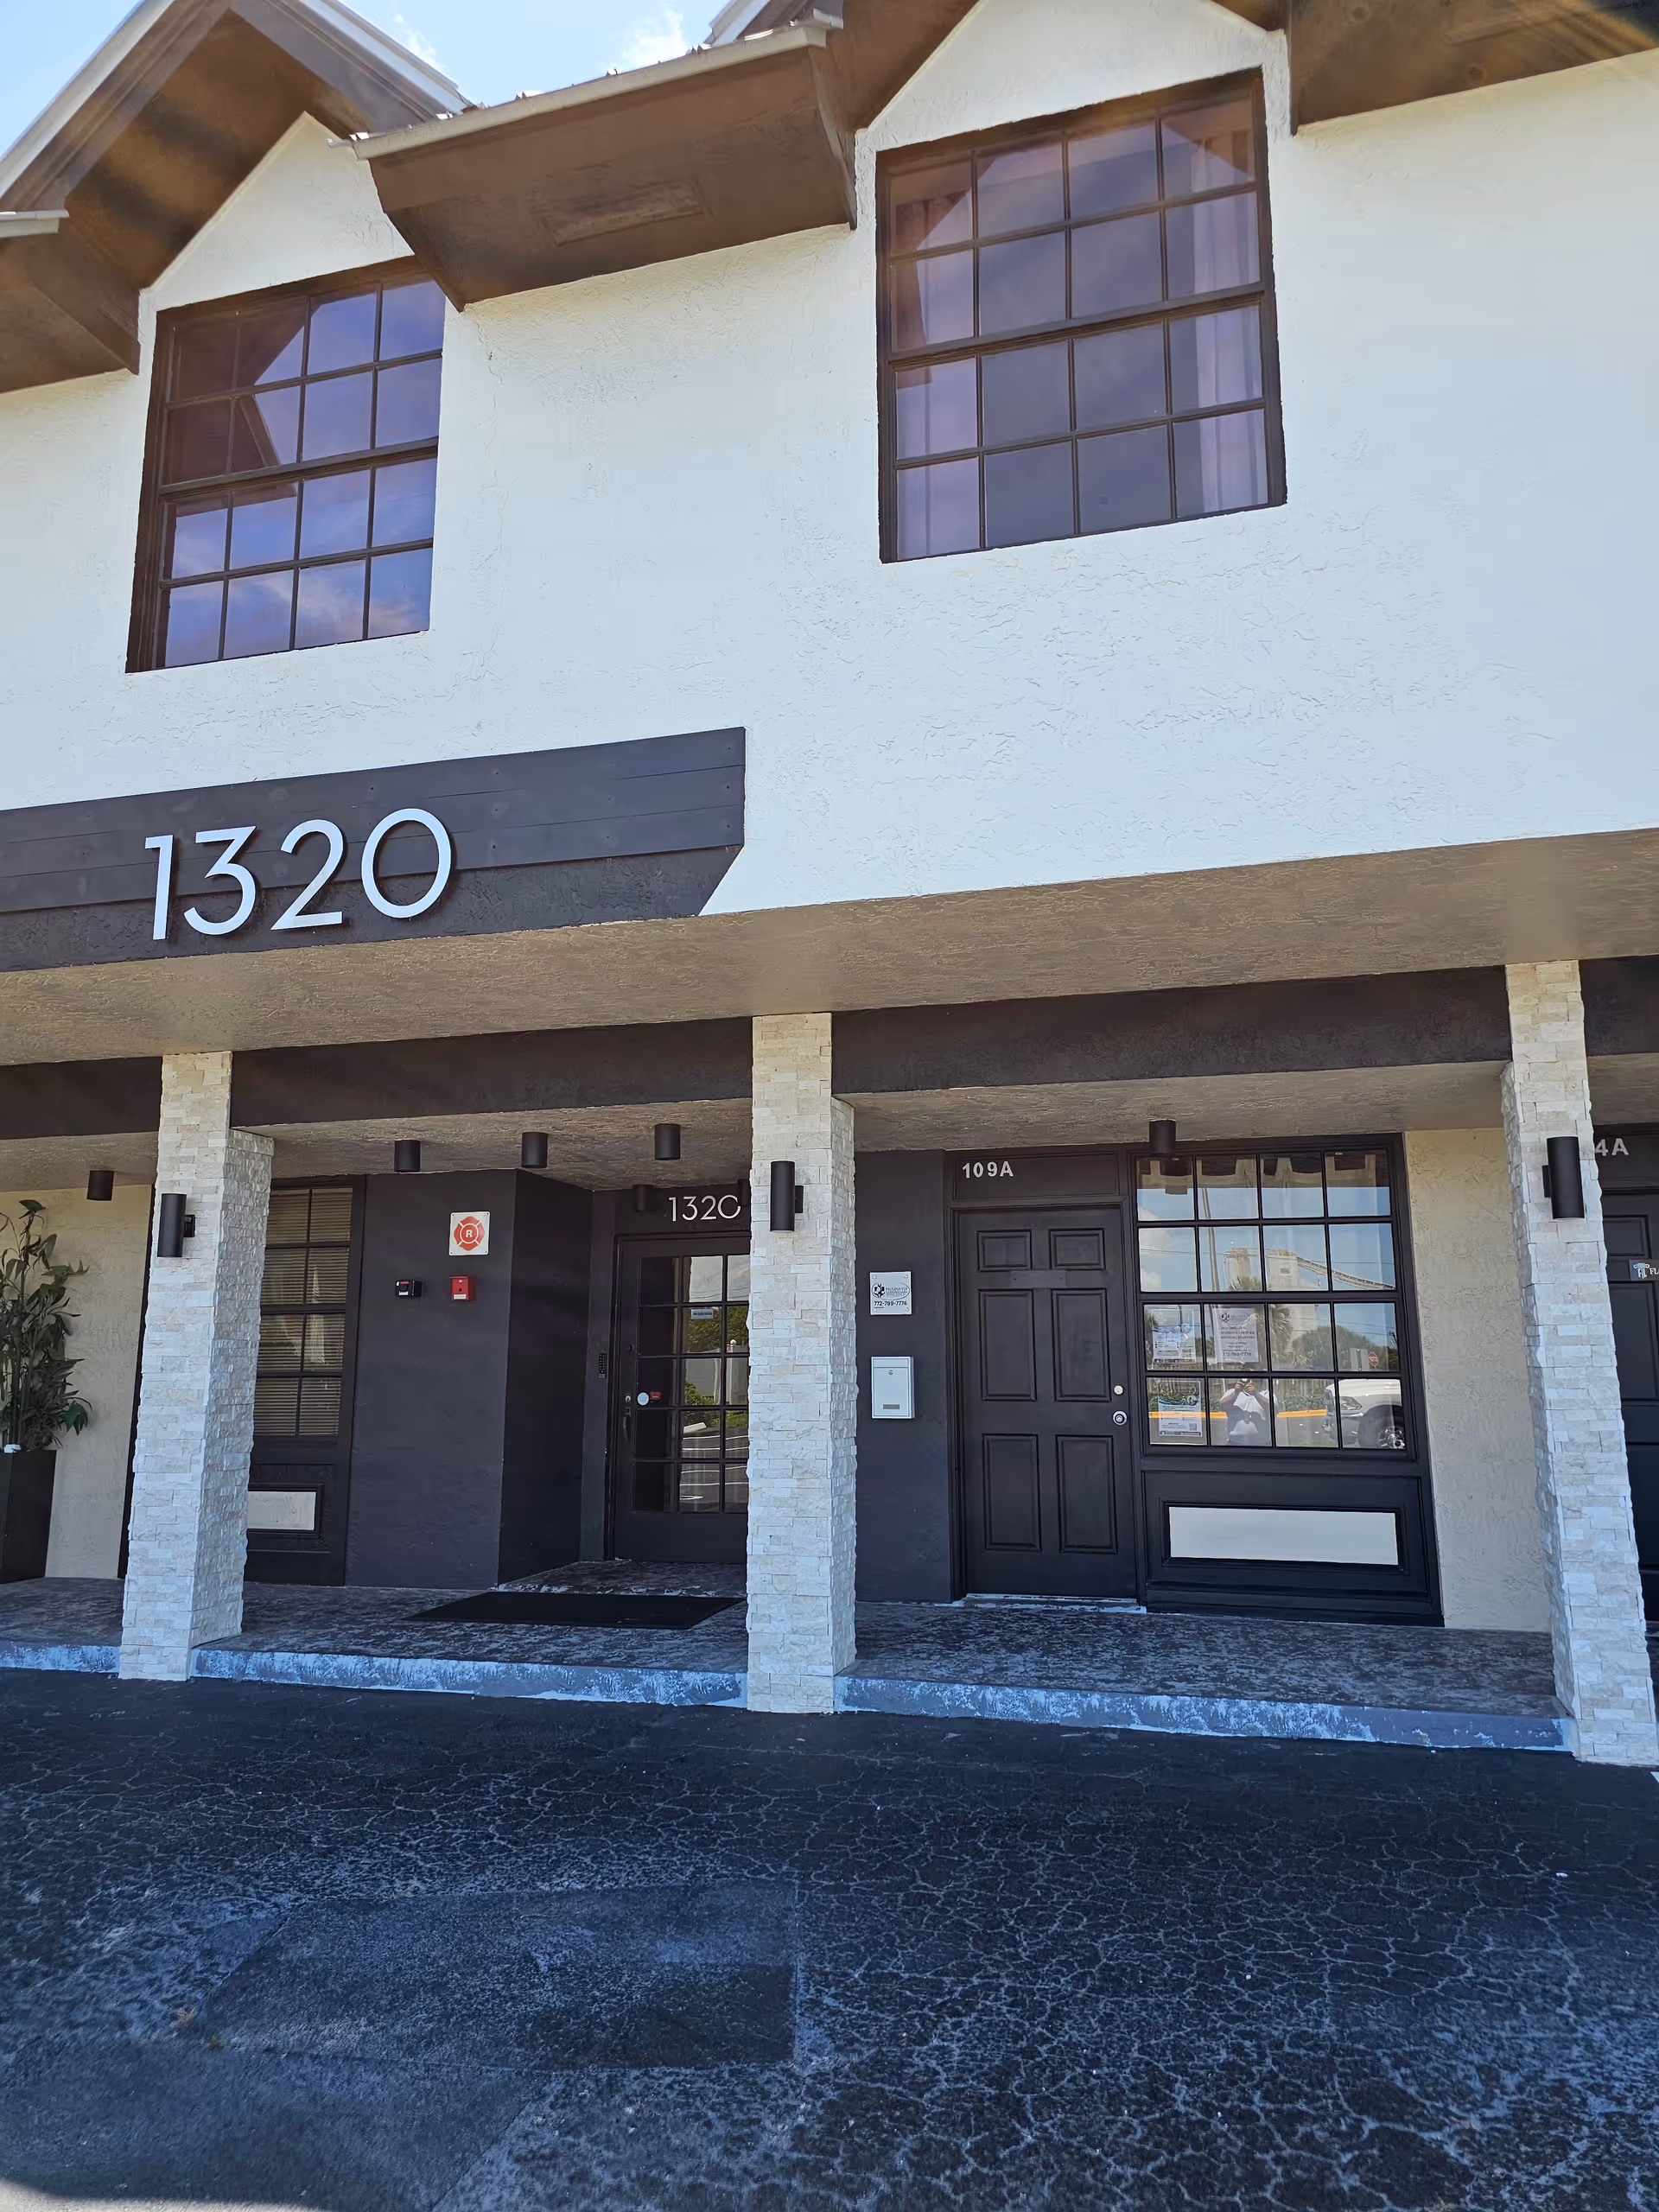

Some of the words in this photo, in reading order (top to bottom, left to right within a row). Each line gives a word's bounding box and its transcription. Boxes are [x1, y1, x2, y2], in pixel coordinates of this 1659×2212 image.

[145, 808, 452, 940] 1320
[962, 1160, 1014, 1179] 109A
[668, 1194, 741, 1222] 1320
[465, 1229, 474, 1238] R
